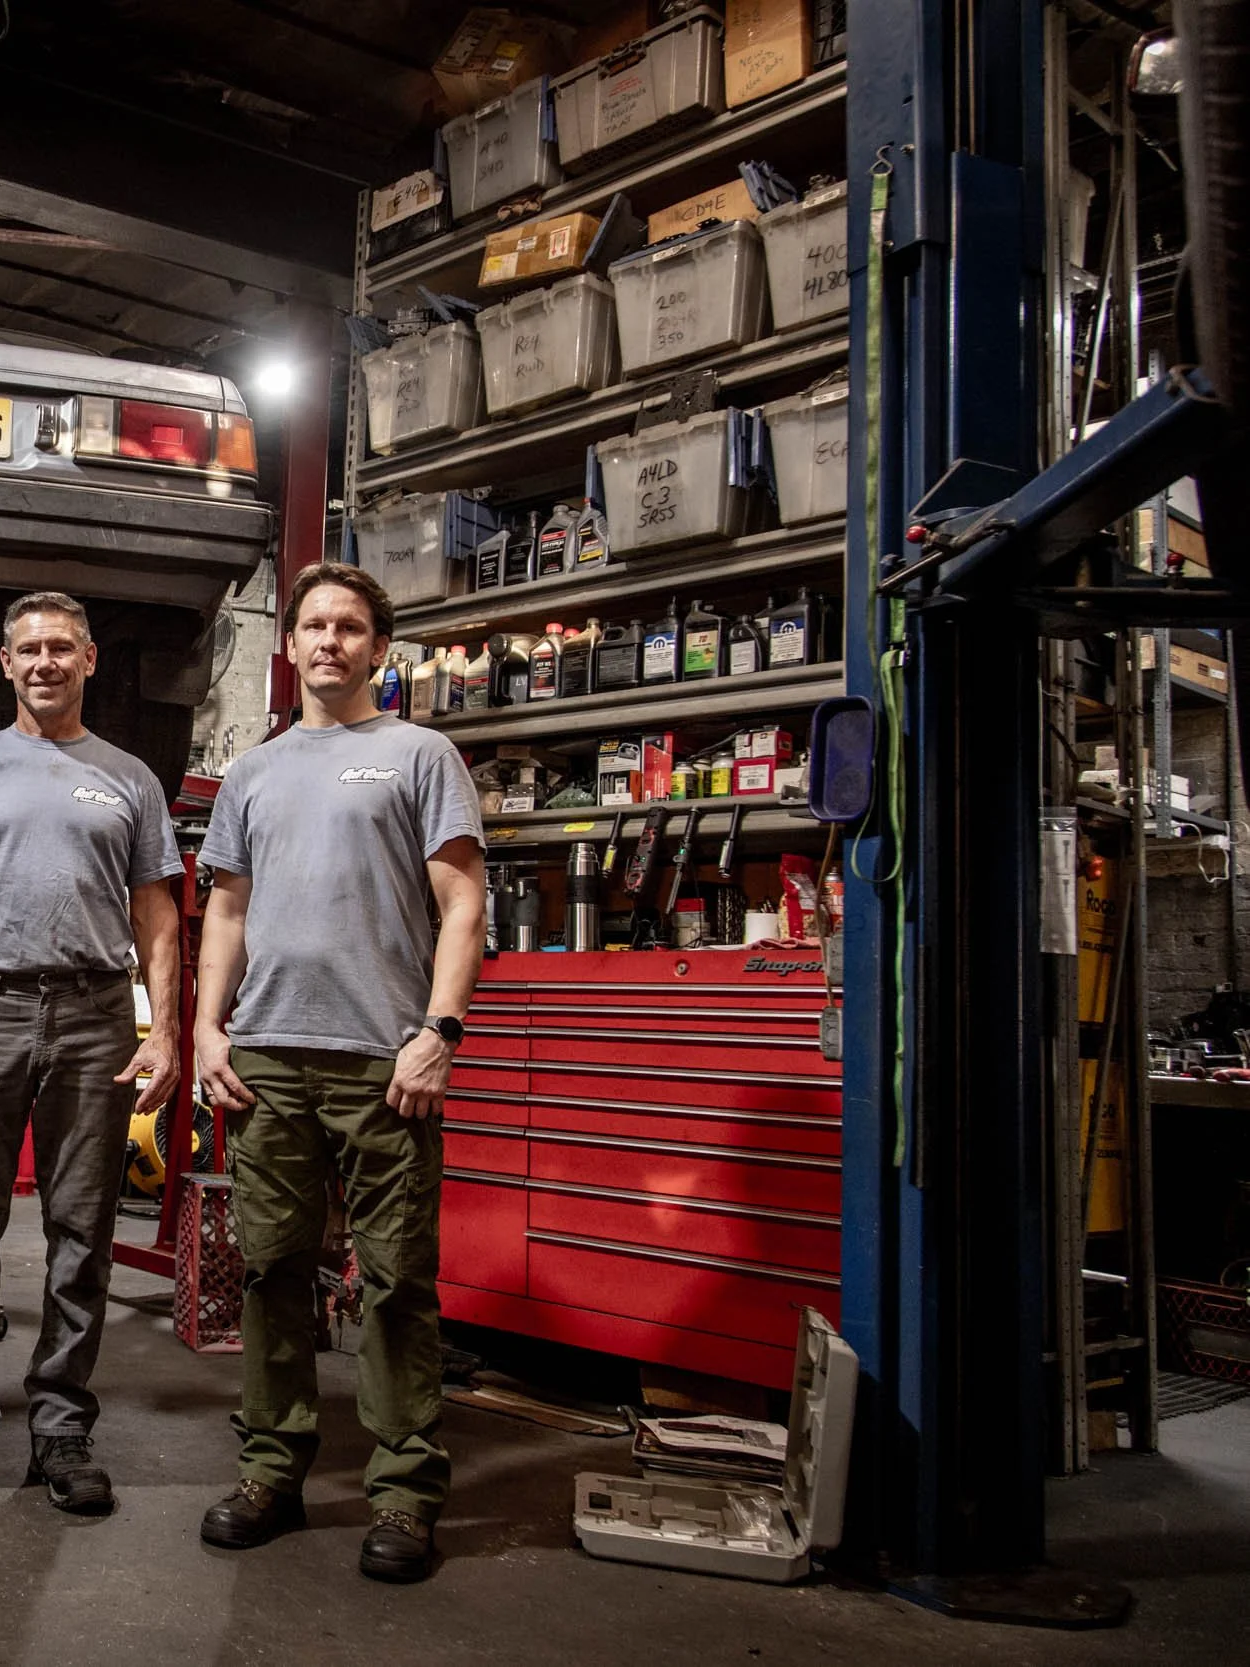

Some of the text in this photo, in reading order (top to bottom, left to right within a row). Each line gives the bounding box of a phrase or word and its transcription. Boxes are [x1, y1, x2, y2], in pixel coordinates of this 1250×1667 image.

[656, 291, 686, 310] 200
[638, 459, 678, 486] A4LD
[638, 505, 677, 528] 5R55
[743, 956, 826, 977] Snap-on
